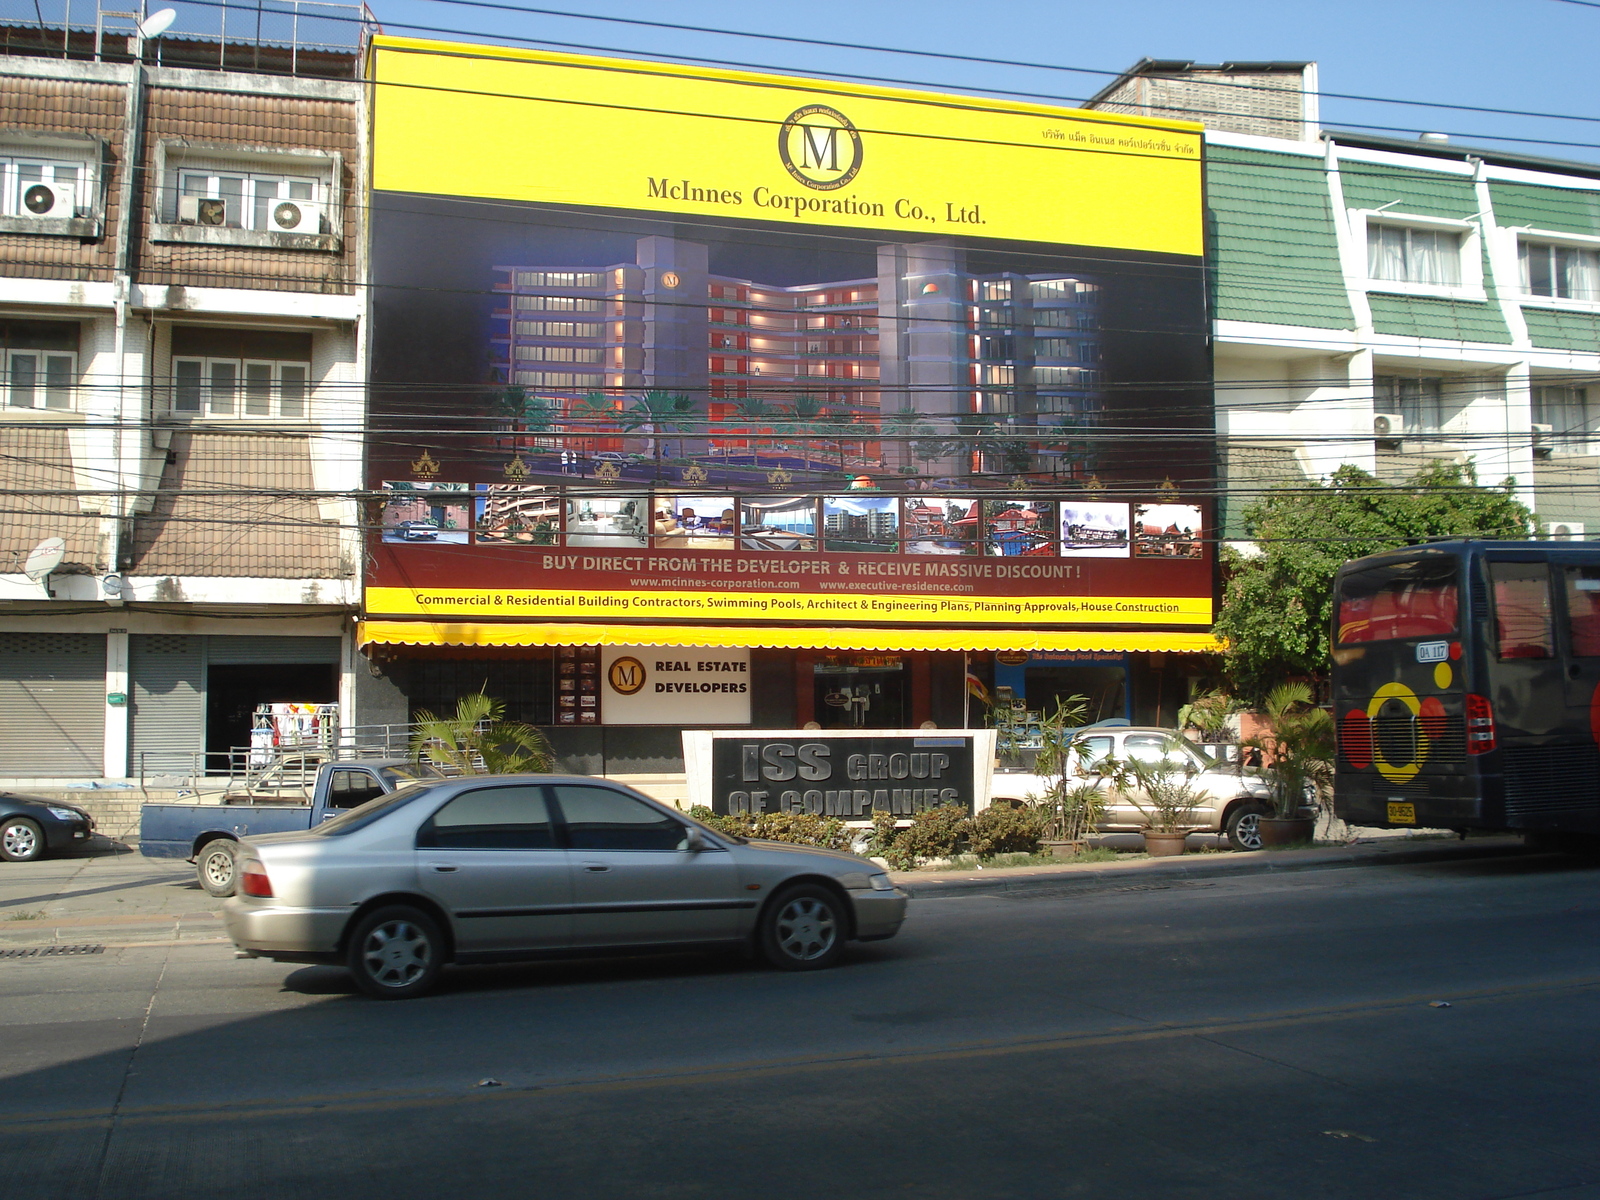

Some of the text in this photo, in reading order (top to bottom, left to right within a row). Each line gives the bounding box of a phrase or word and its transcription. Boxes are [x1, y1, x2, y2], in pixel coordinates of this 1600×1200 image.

[1042, 129, 1065, 140] บริษัท
[800, 124, 842, 172] M
[806, 180, 840, 191] Corporation
[647, 177, 986, 224] McInnes Corporation Co., Ltd.
[542, 556, 579, 570] BUY
[583, 557, 643, 571] DIRECT
[649, 558, 697, 571] FROM
[701, 558, 732, 572] THE
[737, 559, 830, 574] DEVELOPER
[838, 561, 850, 574] &
[858, 562, 921, 576] RECEIVE
[925, 563, 992, 577] MASSIVE
[997, 565, 1072, 578] DISCOUNT
[630, 577, 800, 590] www.mcinnes-corporation.com
[820, 580, 974, 592] www.executive-residence.com
[416, 594, 1179, 614] Commercial & Residential Building Contractors, Swimming Pools, Architect & Engineering Plans, Planning Approvals, House Construction
[617, 666, 637, 686] M
[655, 661, 747, 672] REAL ESTATE
[655, 683, 747, 693] DEVELOPERS
[742, 743, 950, 782] ISS GROUP
[728, 788, 959, 817] OF COMPANIES
